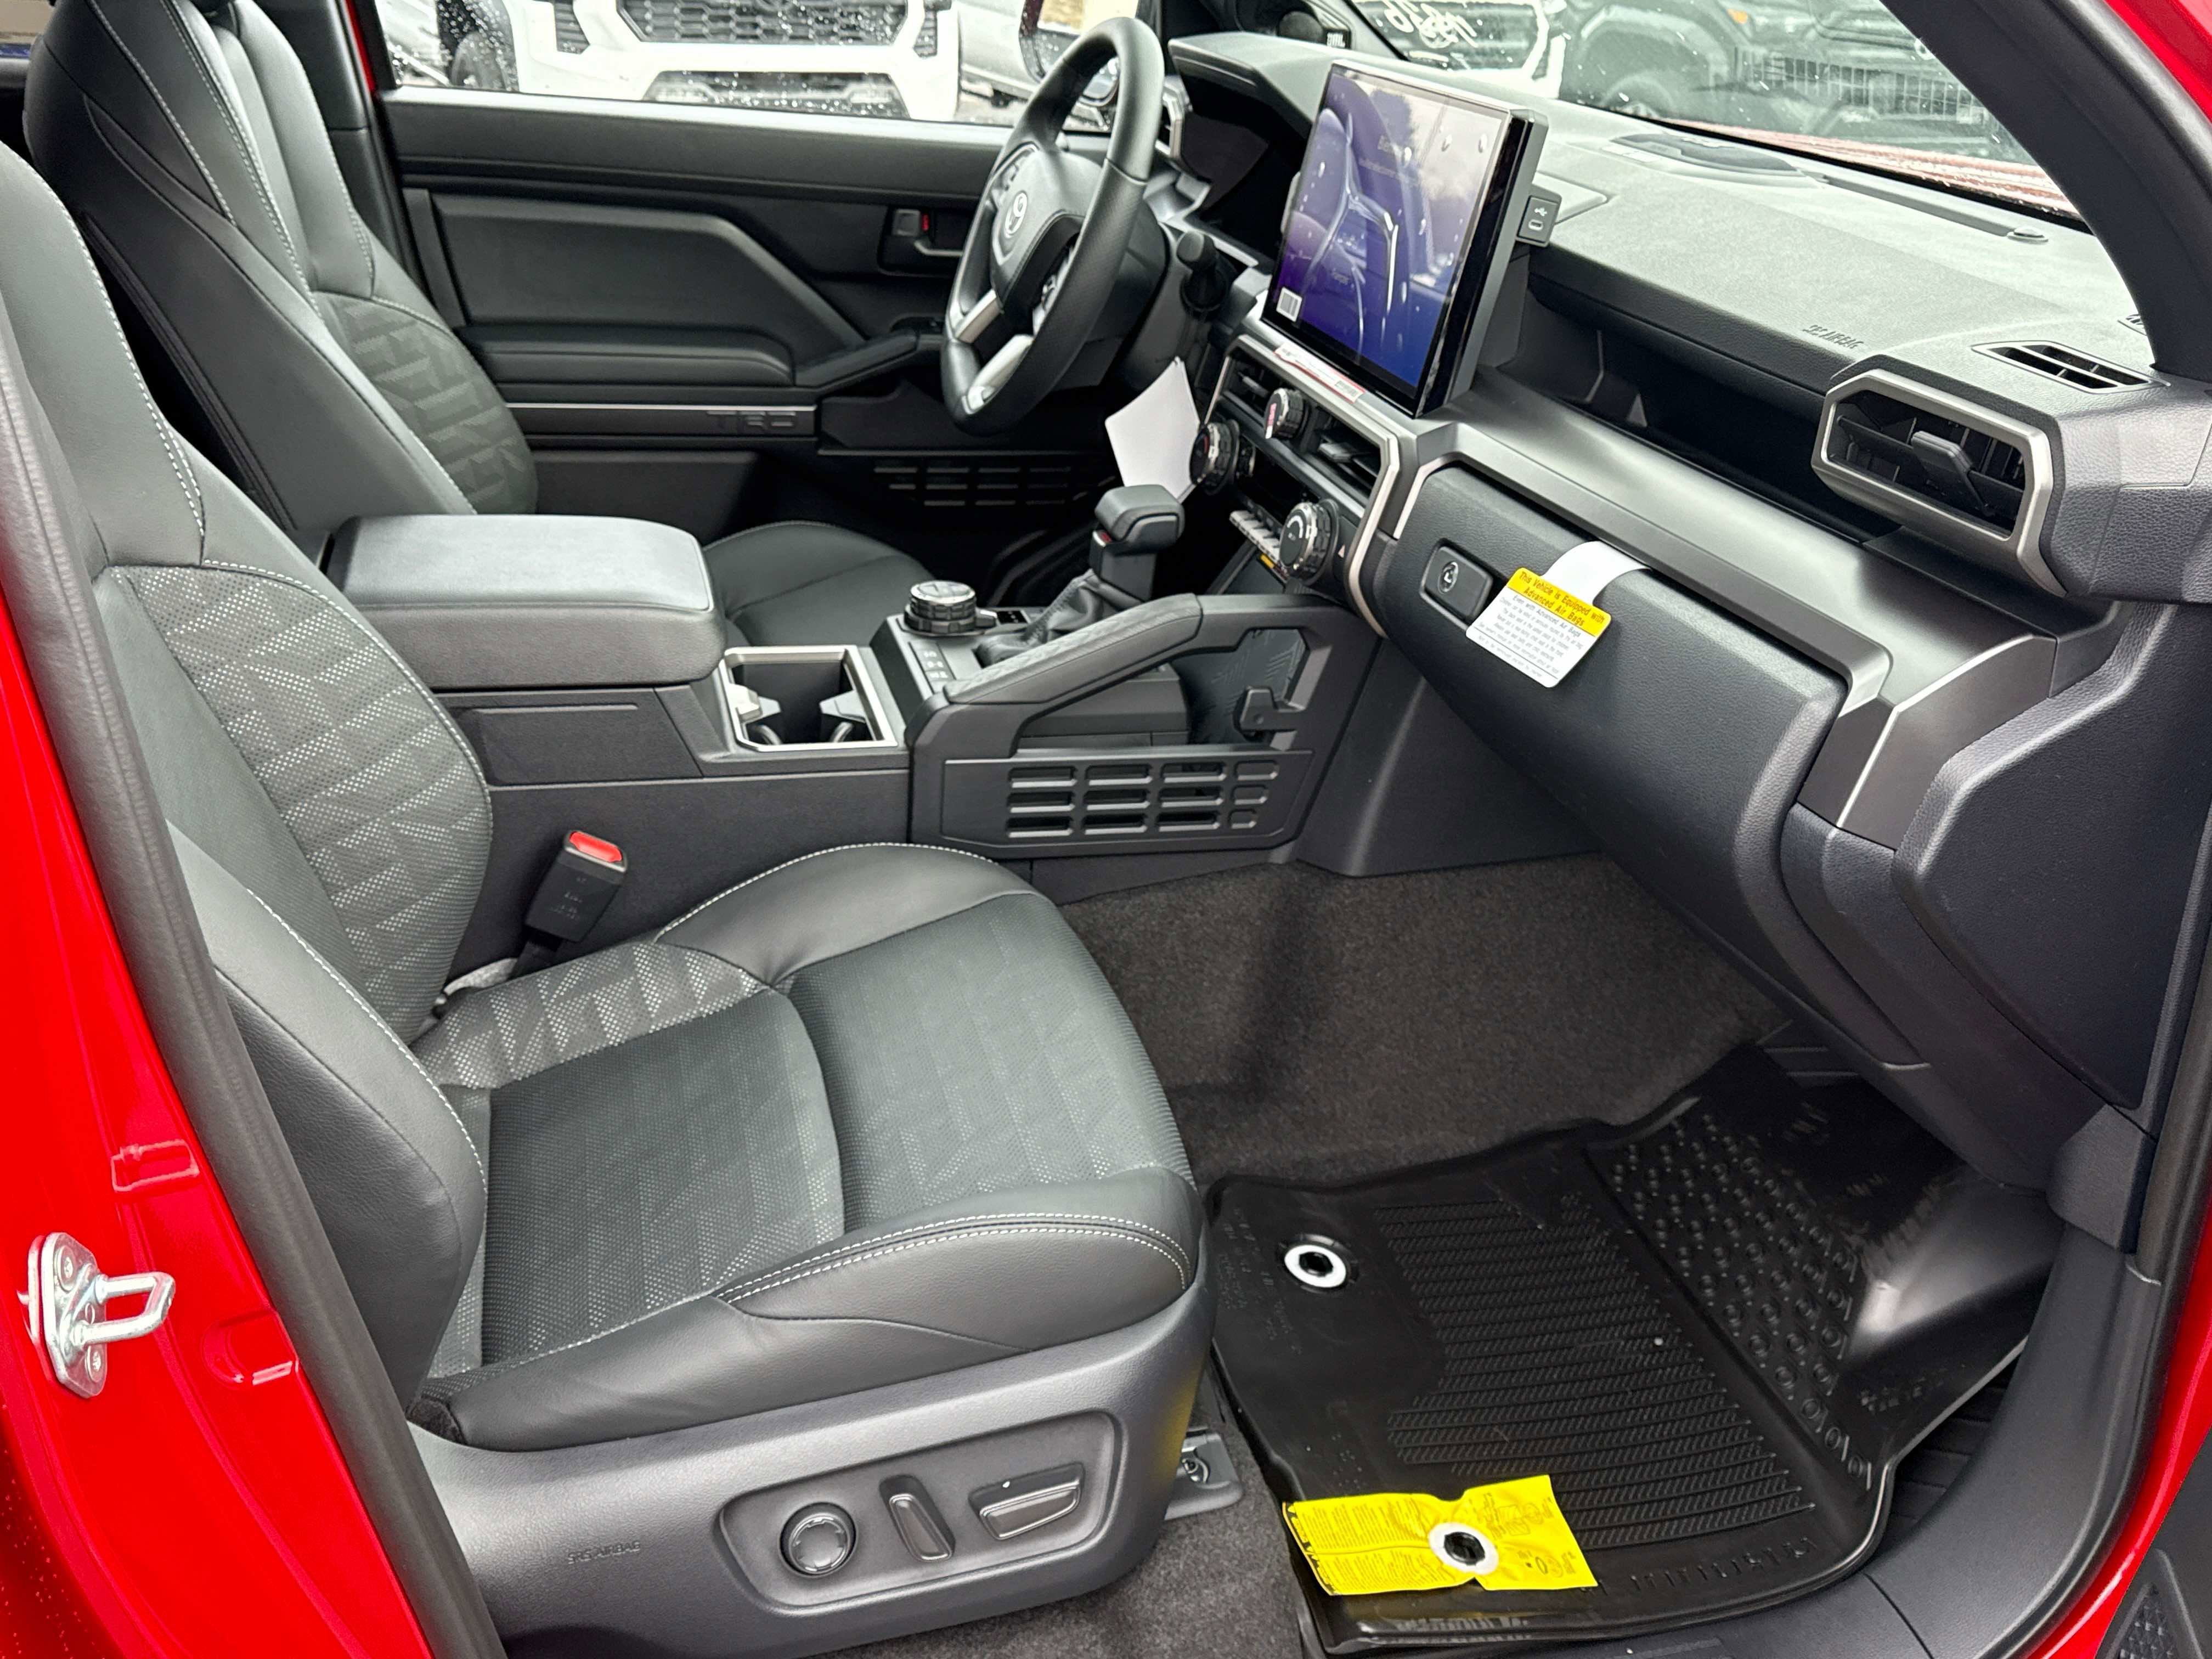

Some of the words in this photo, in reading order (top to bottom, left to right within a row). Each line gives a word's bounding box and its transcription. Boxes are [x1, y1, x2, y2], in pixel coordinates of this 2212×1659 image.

[1519, 571, 1533, 583] This
[1533, 579, 1554, 595] Vehicle
[1555, 591, 1561, 600] is
[1561, 595, 1590, 617] Equipped
[1523, 587, 1555, 608] Advanced
[1555, 605, 1567, 616] Air
[1567, 612, 1585, 626] Bags
[567, 1550, 592, 1564] SRS
[592, 1541, 641, 1559] AIRBAG
